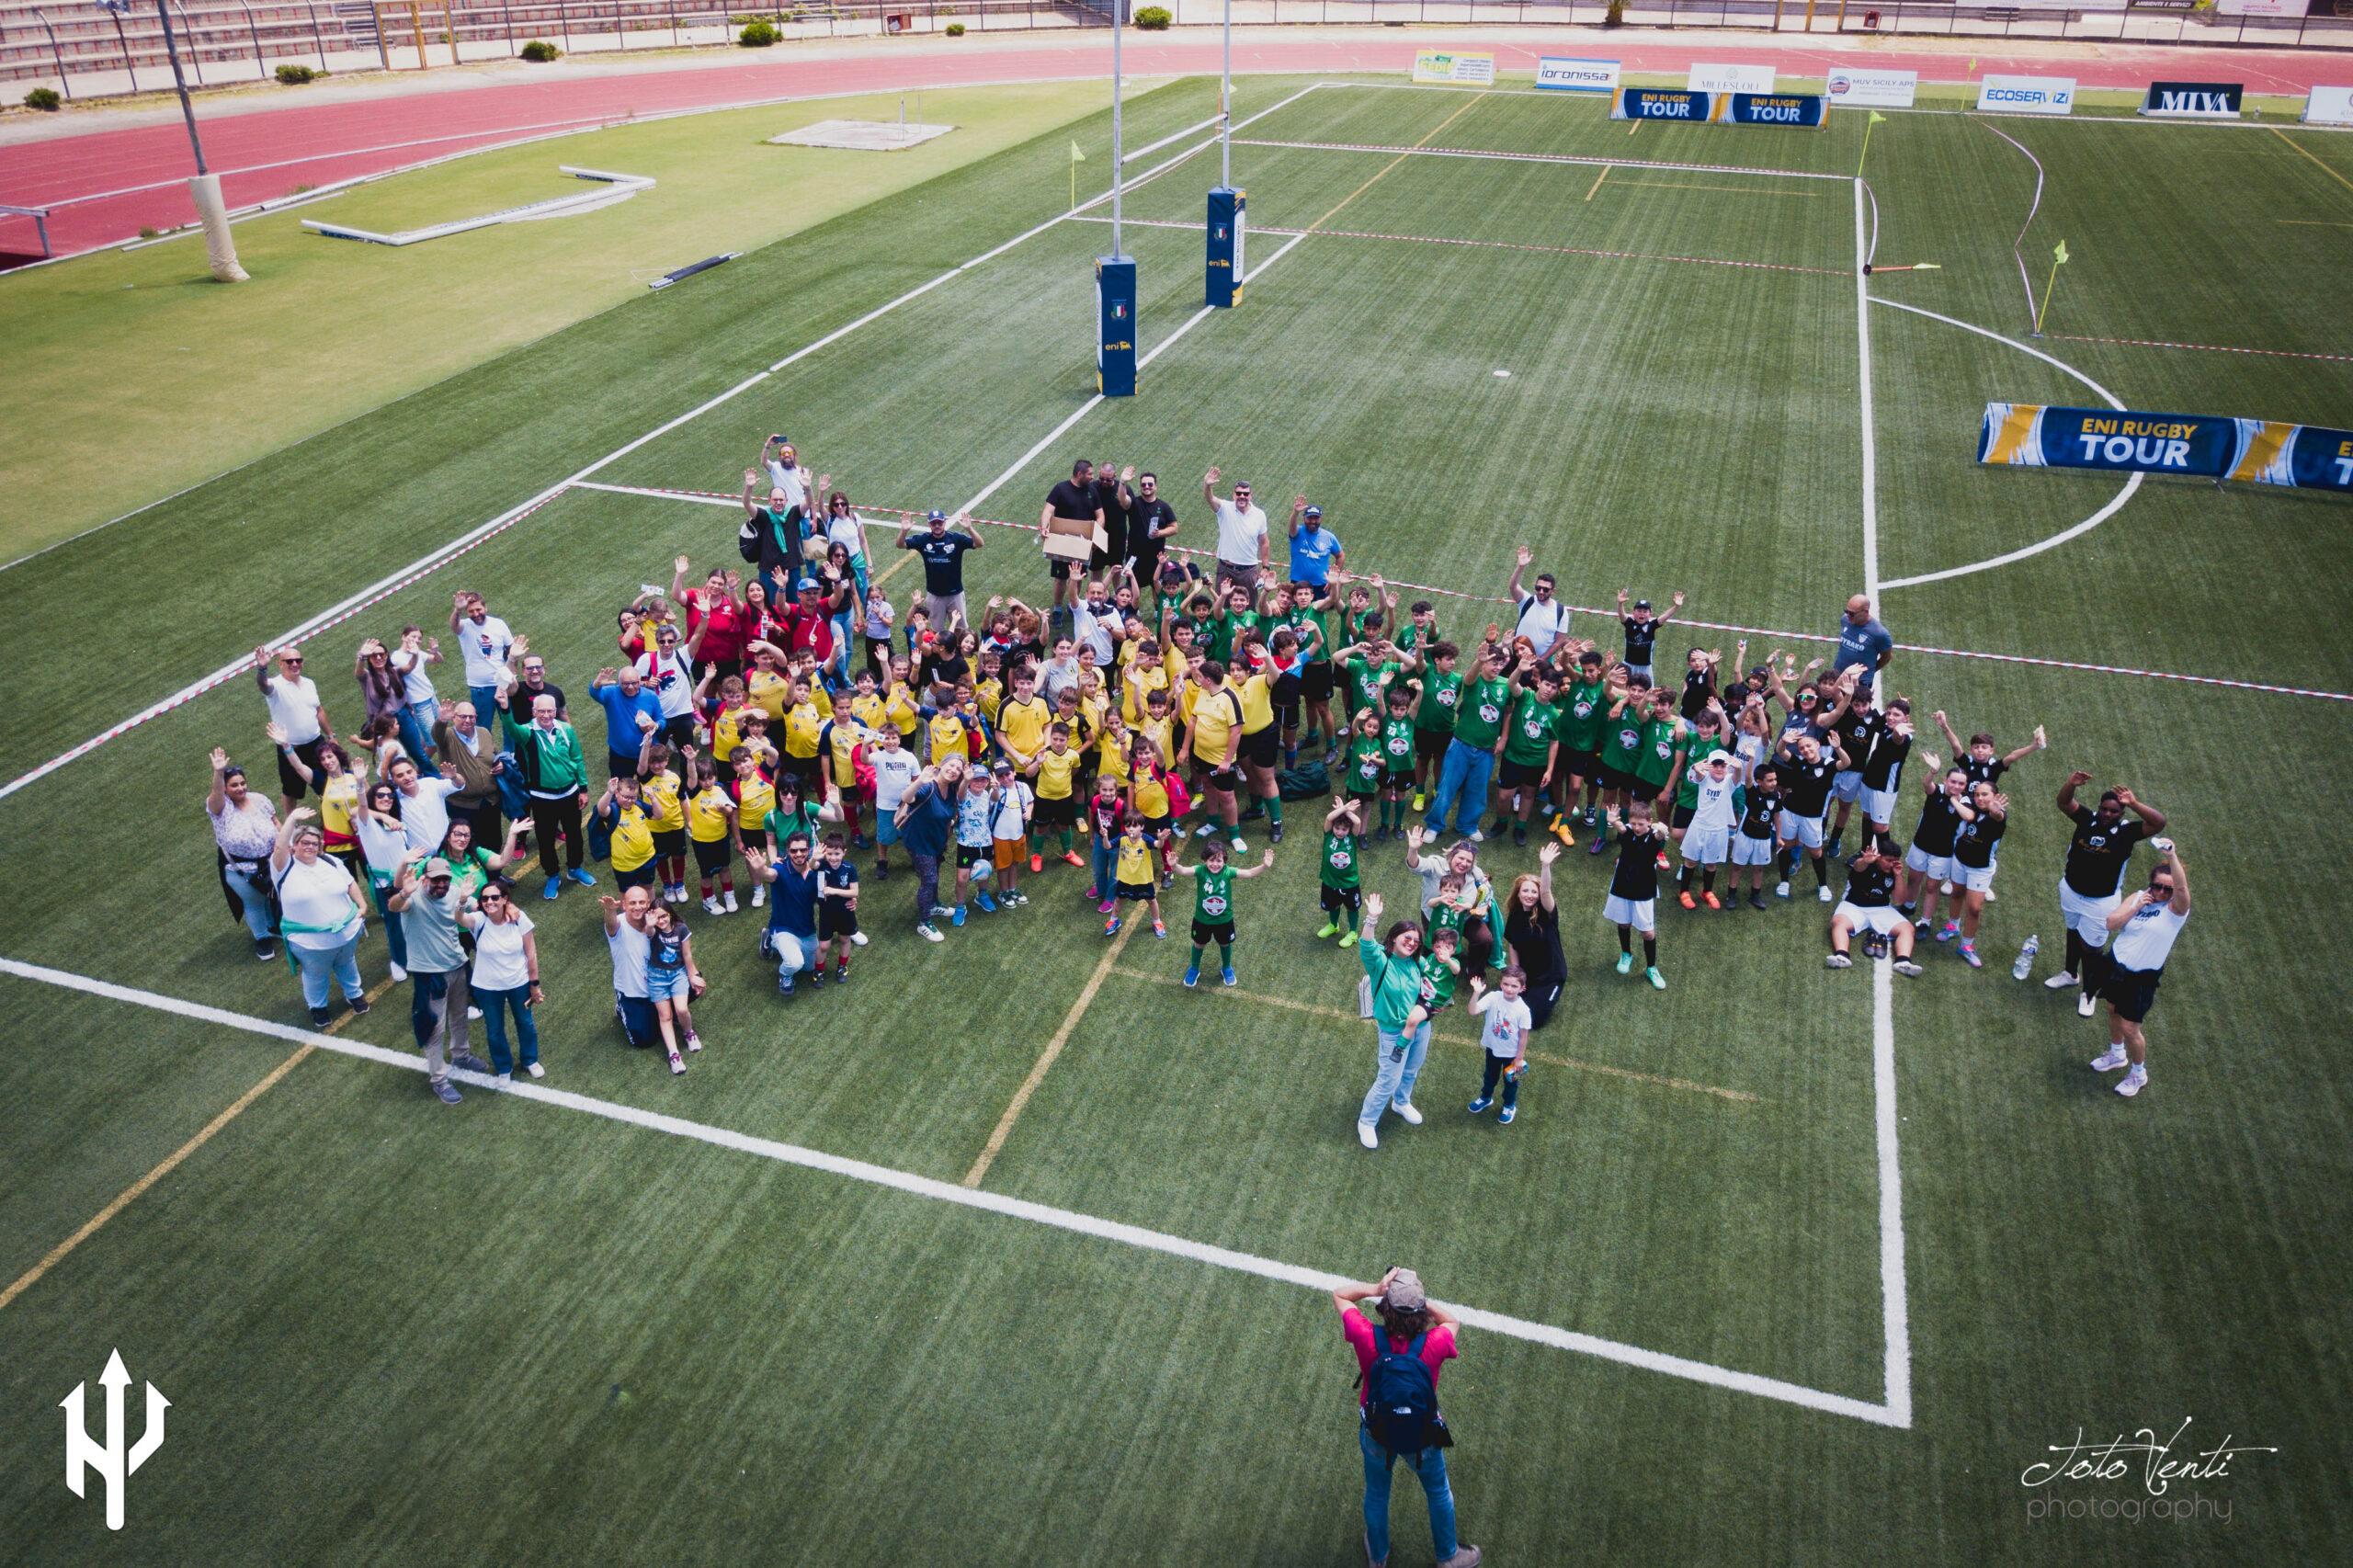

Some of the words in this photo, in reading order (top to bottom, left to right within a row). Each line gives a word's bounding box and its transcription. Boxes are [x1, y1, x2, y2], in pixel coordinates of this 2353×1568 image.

[1642, 93, 1657, 102] ENI
[1659, 94, 1691, 104] RUGBY
[1751, 97, 1768, 107] ENI
[1769, 98, 1802, 108] RUGBY
[2161, 90, 2229, 112] MIVA
[1641, 101, 1690, 118] TOUR
[1750, 106, 1801, 122] TOUR
[2081, 417, 2119, 434] ENI
[2123, 420, 2199, 440] RUGBY
[2079, 434, 2190, 467] TOUR
